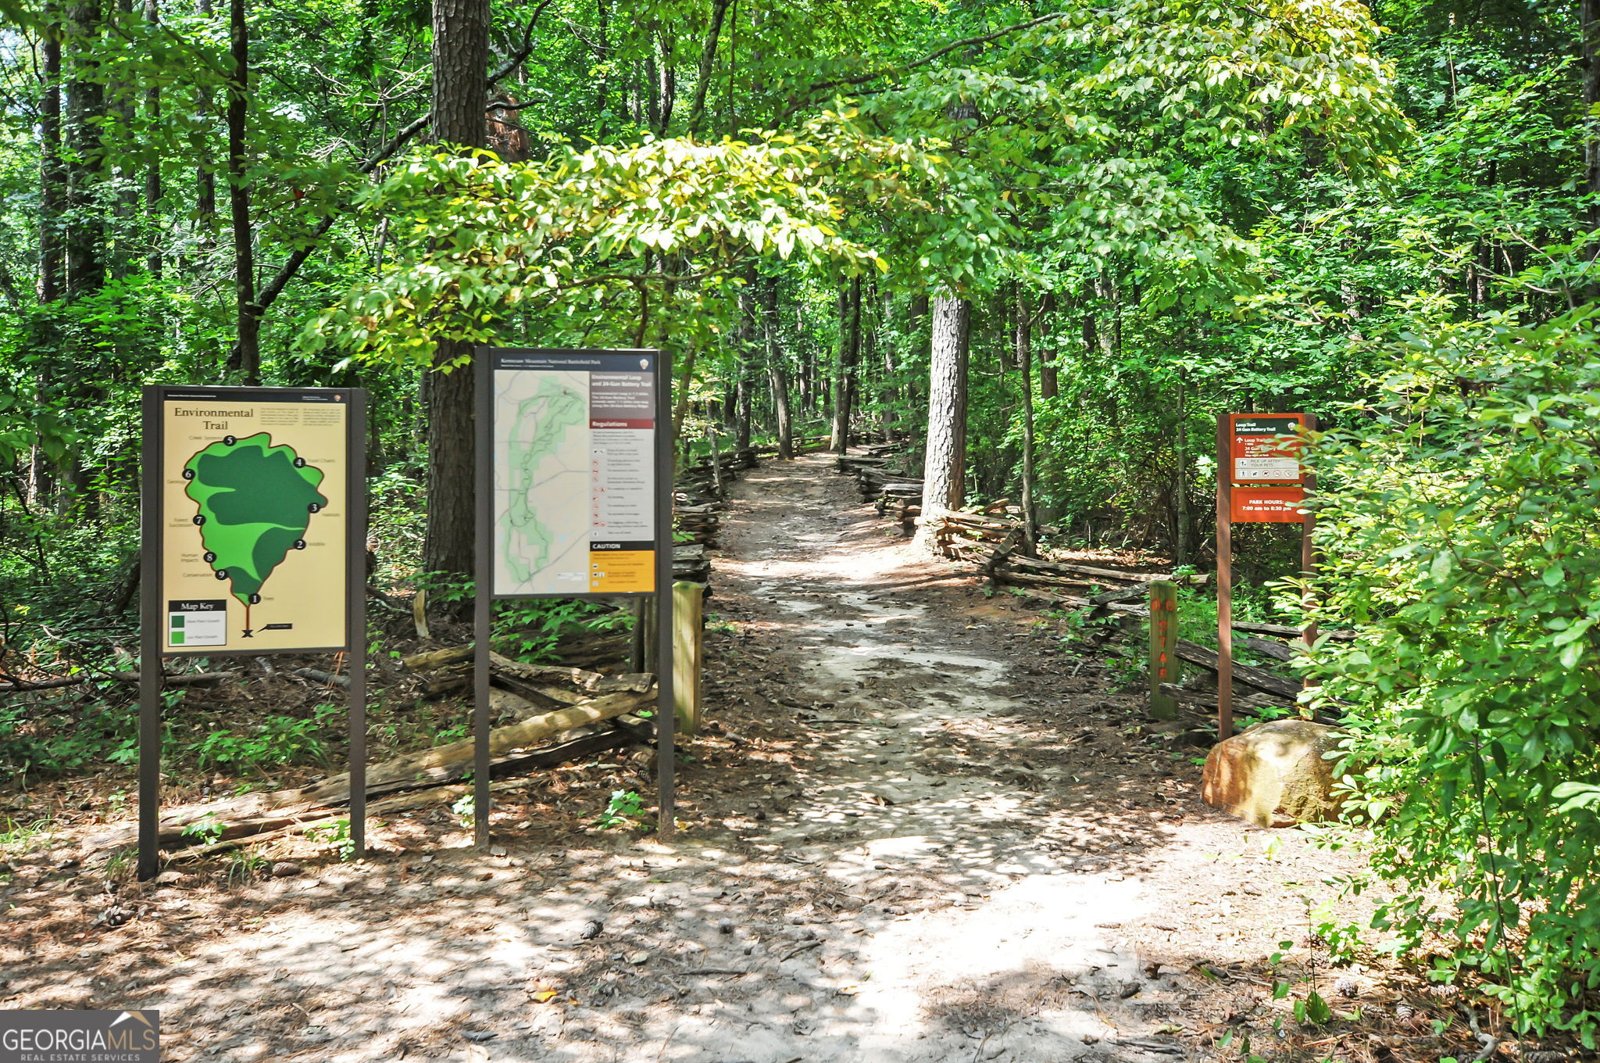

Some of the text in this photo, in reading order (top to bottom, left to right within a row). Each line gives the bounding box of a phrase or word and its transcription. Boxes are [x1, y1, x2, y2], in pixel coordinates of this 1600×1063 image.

[174, 408, 254, 418] Environmental
[203, 421, 228, 430] Trail
[181, 603, 198, 611] Map
